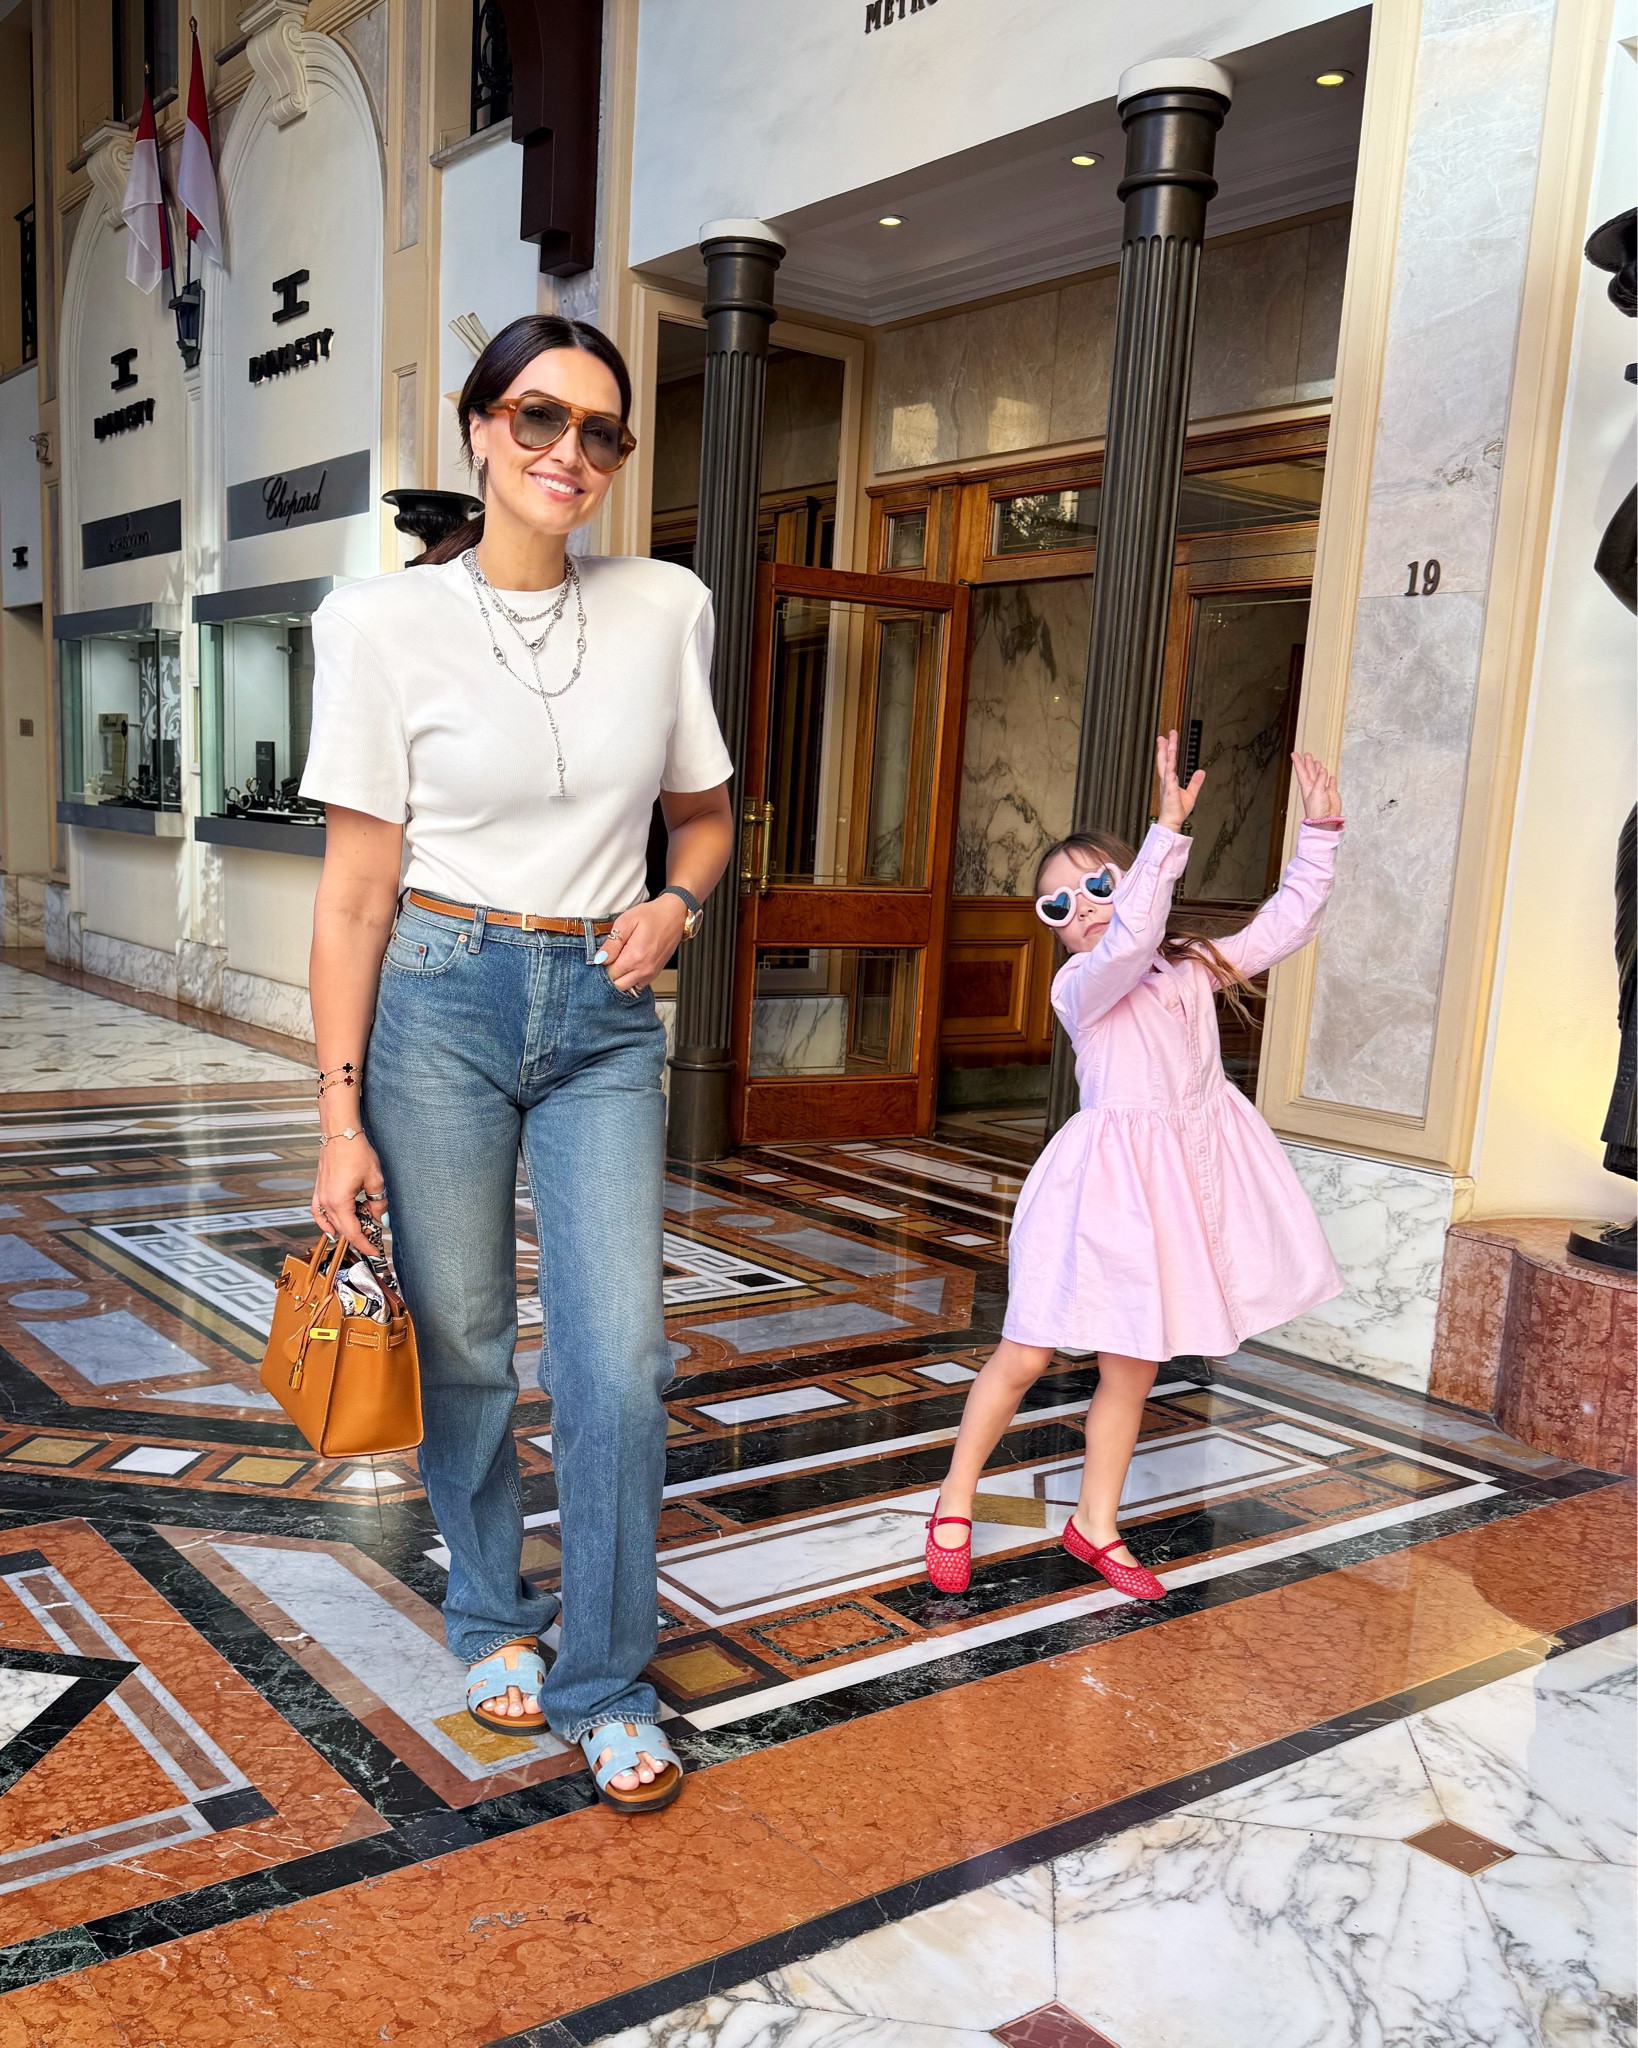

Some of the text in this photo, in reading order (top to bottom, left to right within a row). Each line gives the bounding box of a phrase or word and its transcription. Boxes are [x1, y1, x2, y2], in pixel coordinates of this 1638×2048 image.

[864, 0, 938, 34] MET
[262, 469, 327, 527] Chopard
[1403, 558, 1441, 597] 19
